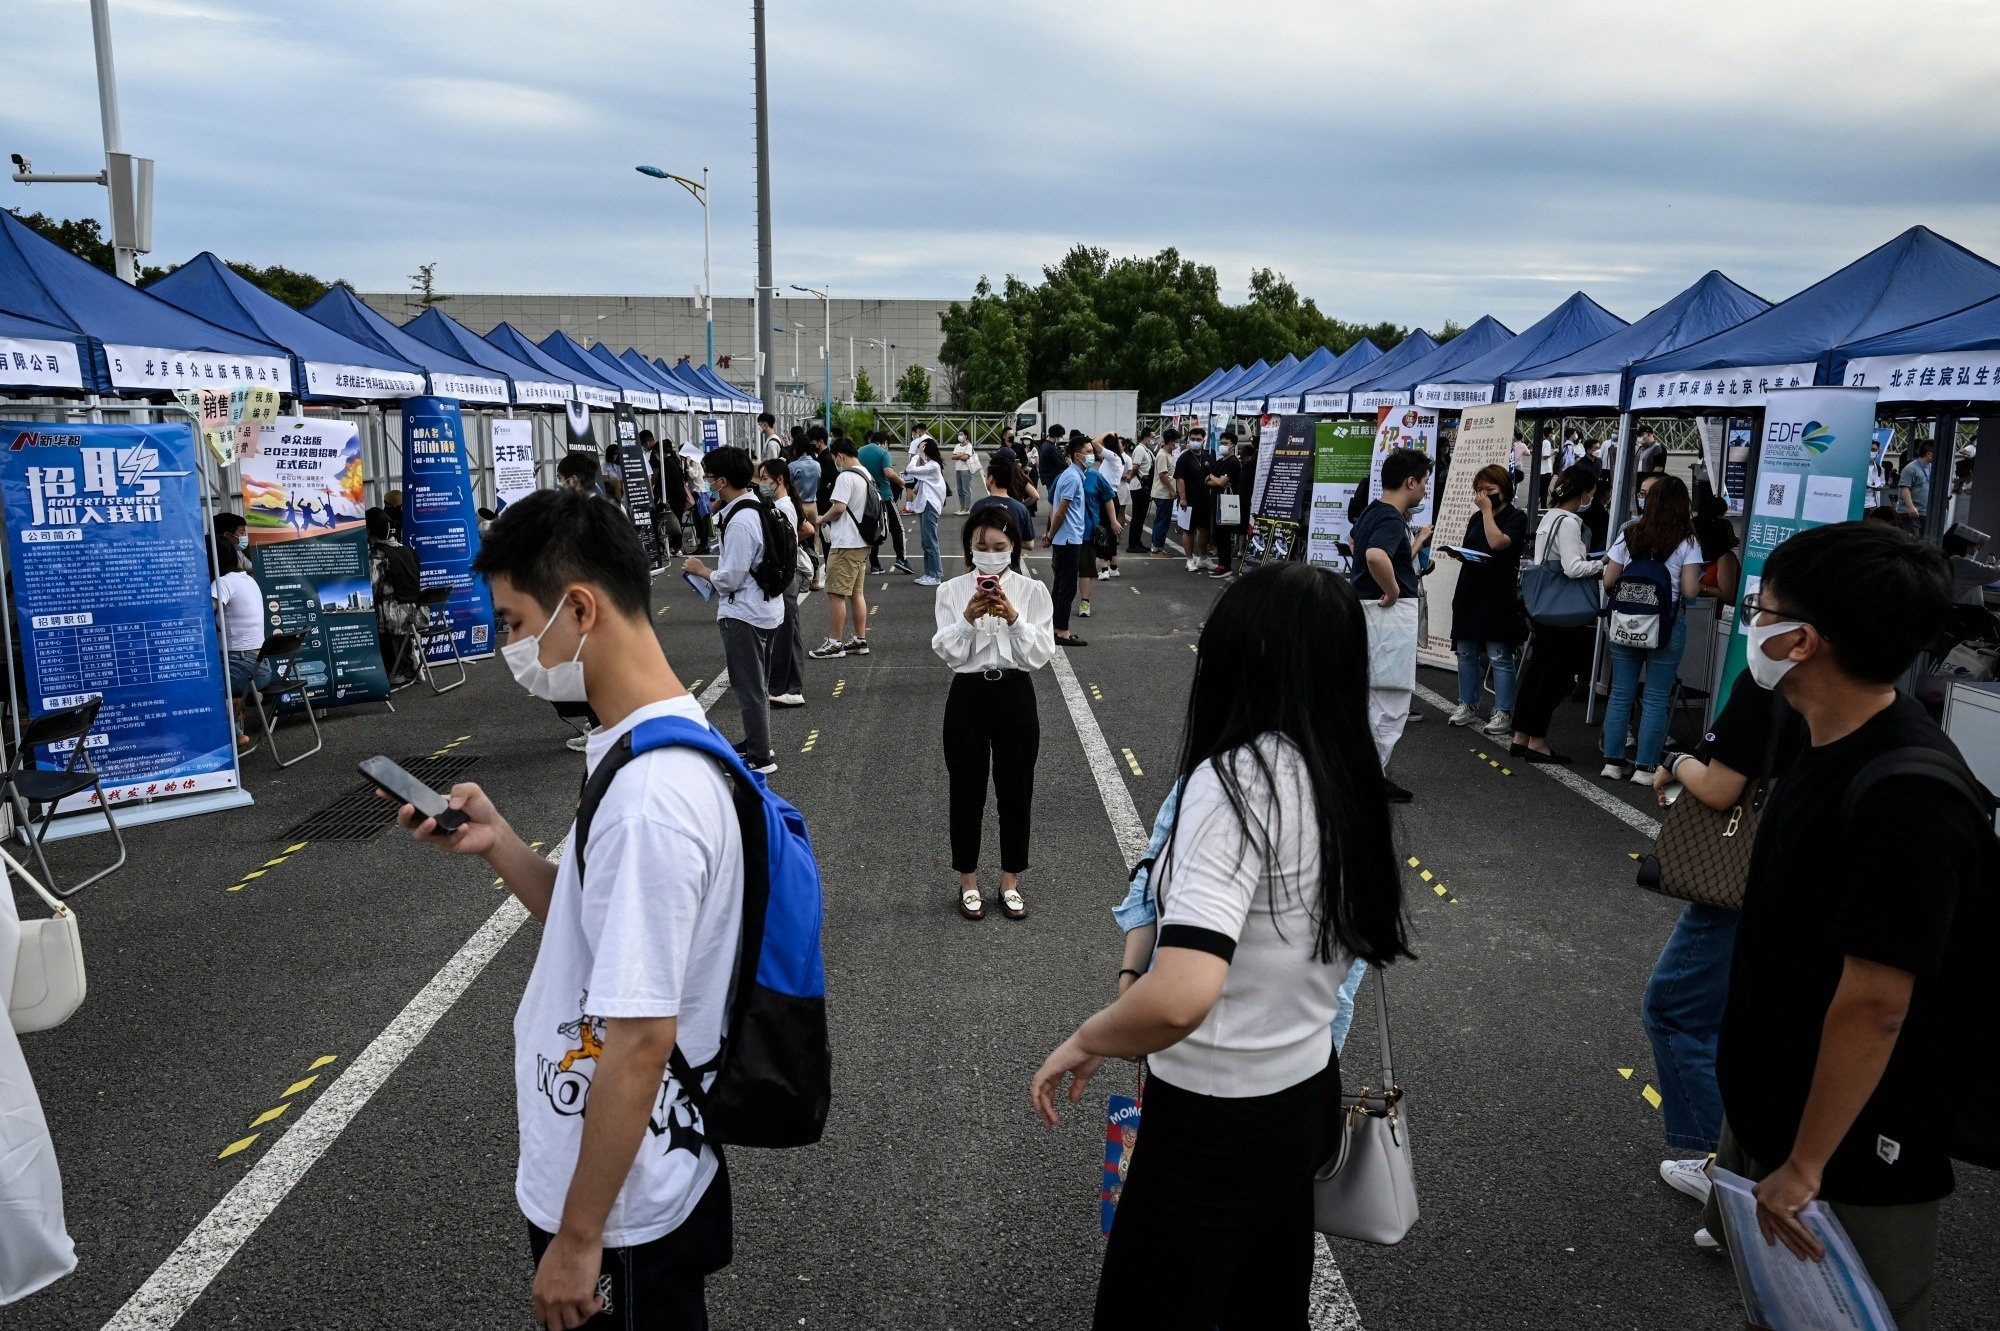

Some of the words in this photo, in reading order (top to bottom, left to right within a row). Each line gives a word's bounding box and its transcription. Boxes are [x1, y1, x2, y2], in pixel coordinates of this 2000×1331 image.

[115, 358, 123, 373] 5
[145, 359, 279, 382] 北京卓众出版有限公司
[312, 372, 317, 383] 6
[1852, 373, 1865, 387] 27
[255, 391, 273, 404] 视频
[1638, 386, 1647, 398] 26
[203, 395, 229, 419] 销售
[252, 408, 271, 419] 编导
[1767, 422, 1802, 442] EDF
[39, 433, 81, 446] 新华都
[281, 434, 322, 446] 卓众出版
[263, 447, 338, 458] 2023校园招聘
[413, 440, 456, 454] 我们山顶见
[495, 445, 534, 462] 关于我们
[586, 444, 597, 452] CALL
[1766, 444, 1803, 452] ENVIRONMENTAL
[275, 459, 322, 470] 正式启动！
[24, 436, 191, 526] 招聘
[47, 496, 160, 507] ADVERTISEMENT
[47, 505, 163, 525] 加入我们
[27, 530, 77, 541] 公司简介
[1749, 522, 1805, 546] 美国环
[37, 614, 87, 627] 招聘职位
[1615, 629, 1648, 642] KENZO
[87, 779, 196, 804] 寻找发光的你
